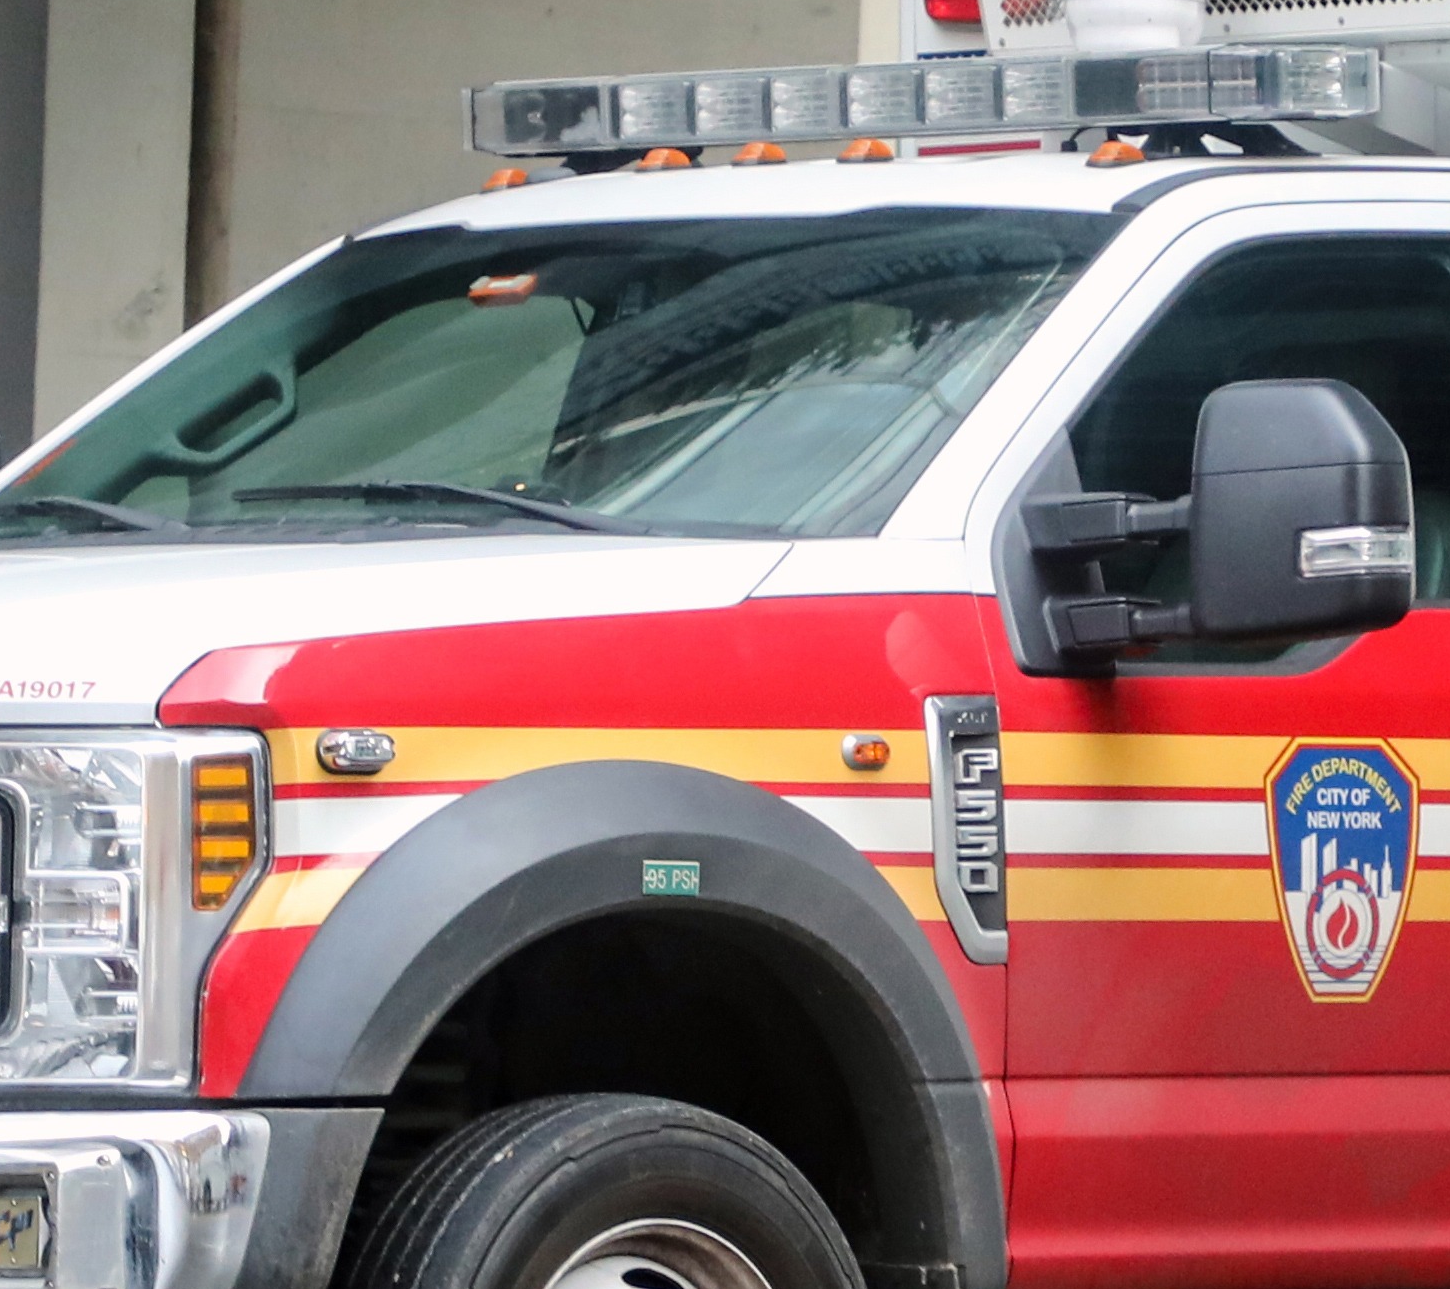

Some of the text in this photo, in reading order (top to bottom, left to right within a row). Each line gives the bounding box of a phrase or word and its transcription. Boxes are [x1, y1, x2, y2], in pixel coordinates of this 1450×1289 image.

[1285, 757, 1403, 815] FIRE DEPARTMENT
[1316, 787, 1372, 807] CITY OF
[1307, 811, 1383, 830] NEW YORK
[647, 868, 696, 890] 95 PSI
